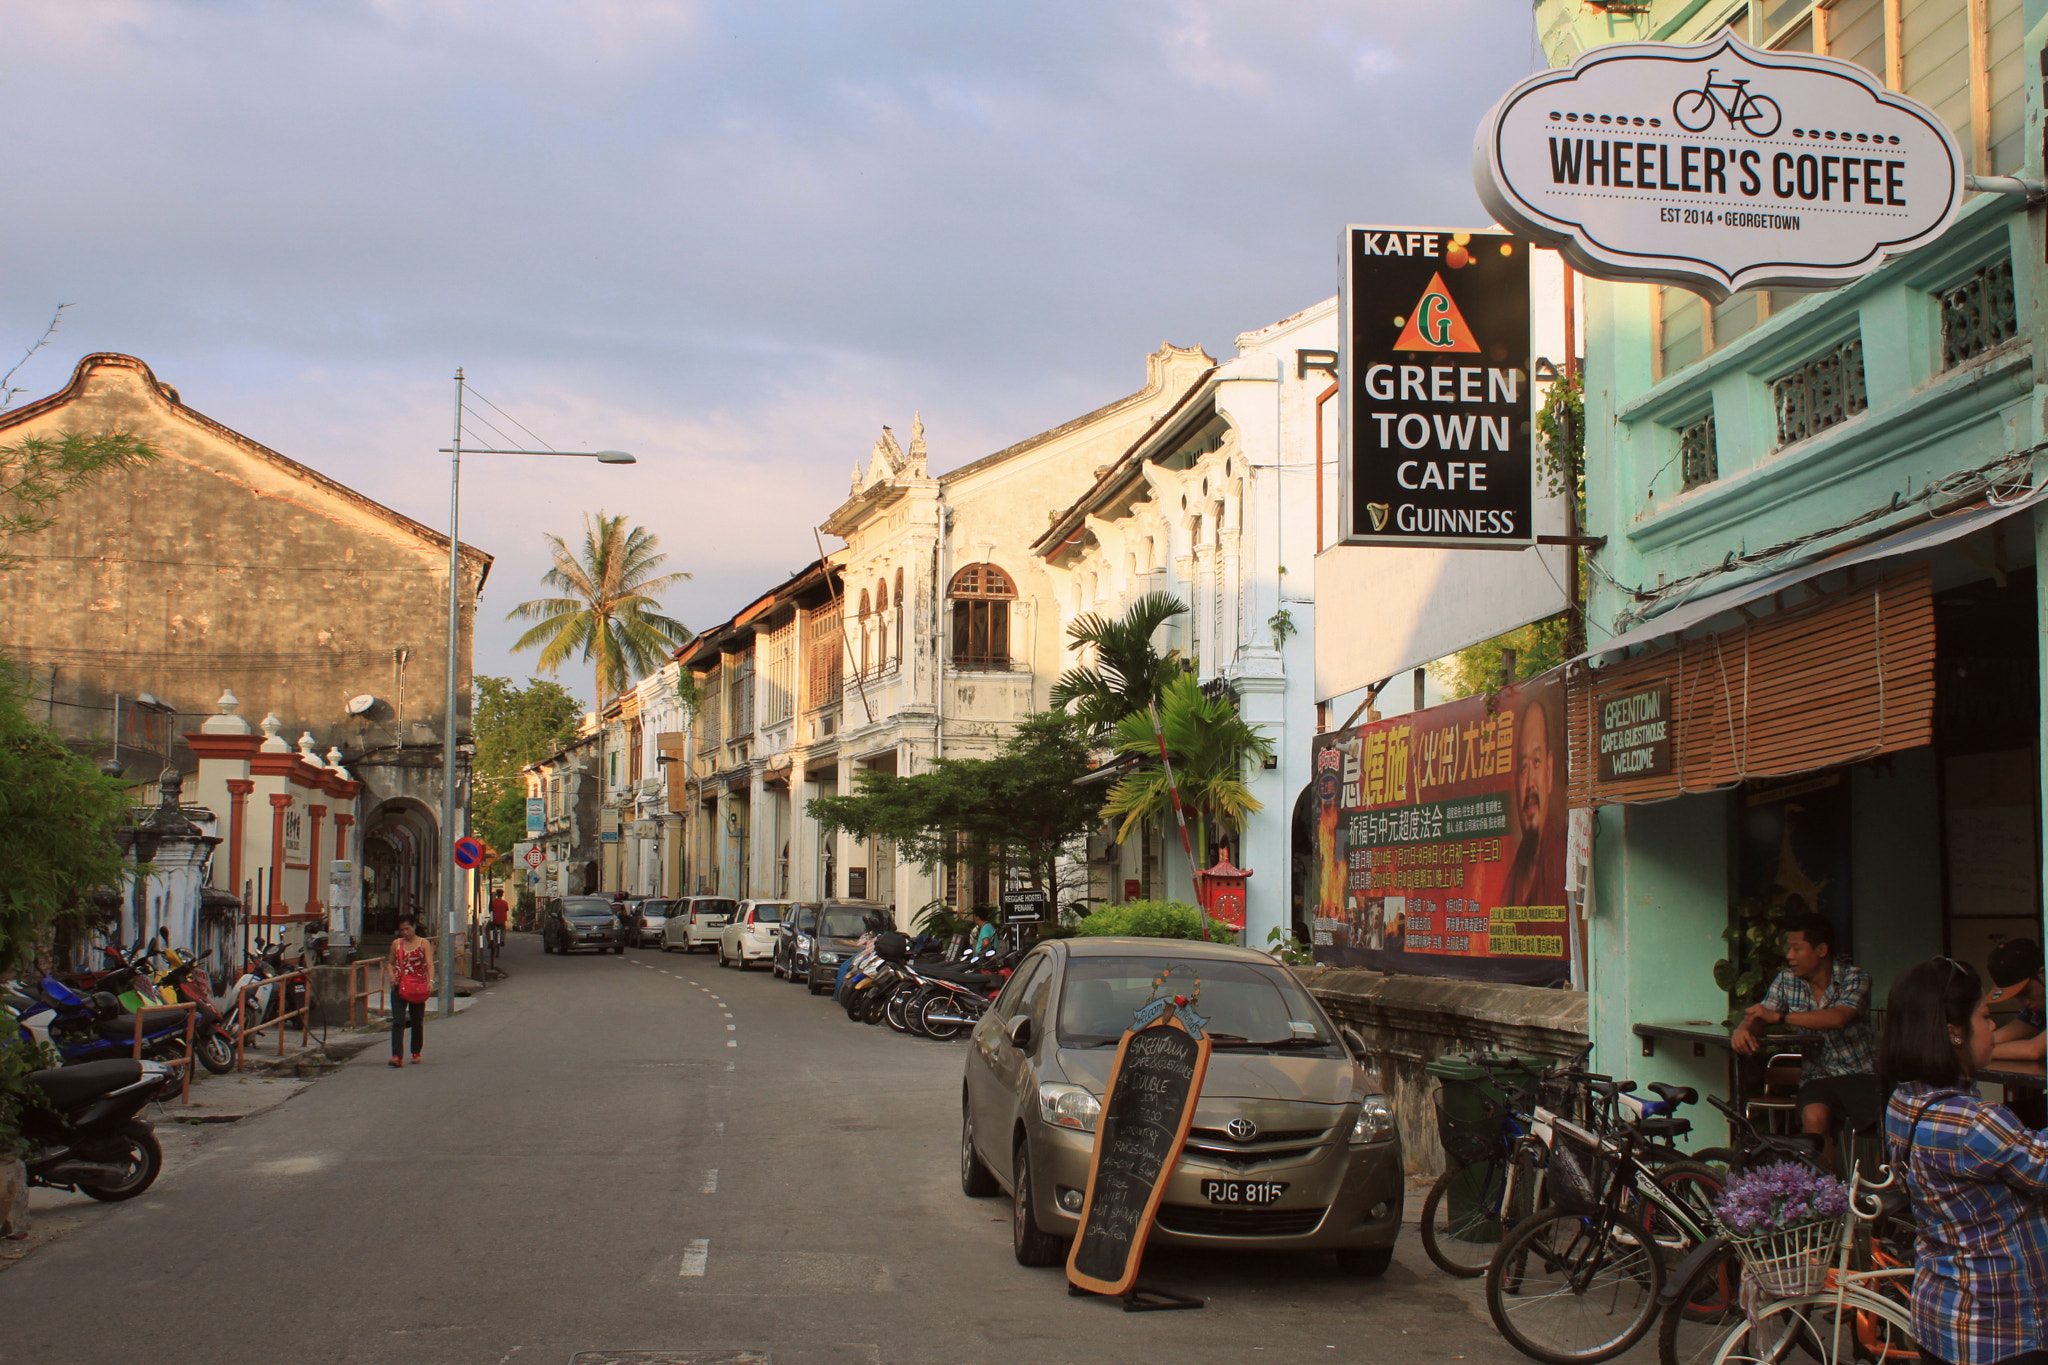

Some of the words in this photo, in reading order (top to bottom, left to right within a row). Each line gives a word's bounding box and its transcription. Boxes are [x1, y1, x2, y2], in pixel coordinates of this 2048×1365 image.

[1548, 136, 1762, 197] WHEELER'S
[1772, 151, 1907, 207] COFFEE
[1660, 207, 1682, 223] EST
[1684, 209, 1714, 226] 2014
[1724, 211, 1801, 231] GEORGETOWN
[1363, 232, 1440, 258] KAFE
[1364, 364, 1517, 404] GREEN
[1371, 412, 1510, 452] TOWN
[1396, 460, 1488, 491] CAFE
[1396, 503, 1515, 534] GUINNESS
[1604, 690, 1661, 730] GREENTOWN
[1600, 731, 1618, 754] CAFE
[1624, 720, 1667, 748] GUESTHOUSE
[1612, 746, 1655, 776] WELCOME
[1349, 804, 1443, 847] 祈福与中元超度法会
[1004, 894, 1025, 903] REGGAE
[1025, 893, 1043, 902] HOSTEL
[1014, 903, 1035, 912] PENANG
[1208, 1182, 1239, 1202] PJG
[1245, 1183, 1282, 1203] 8115
